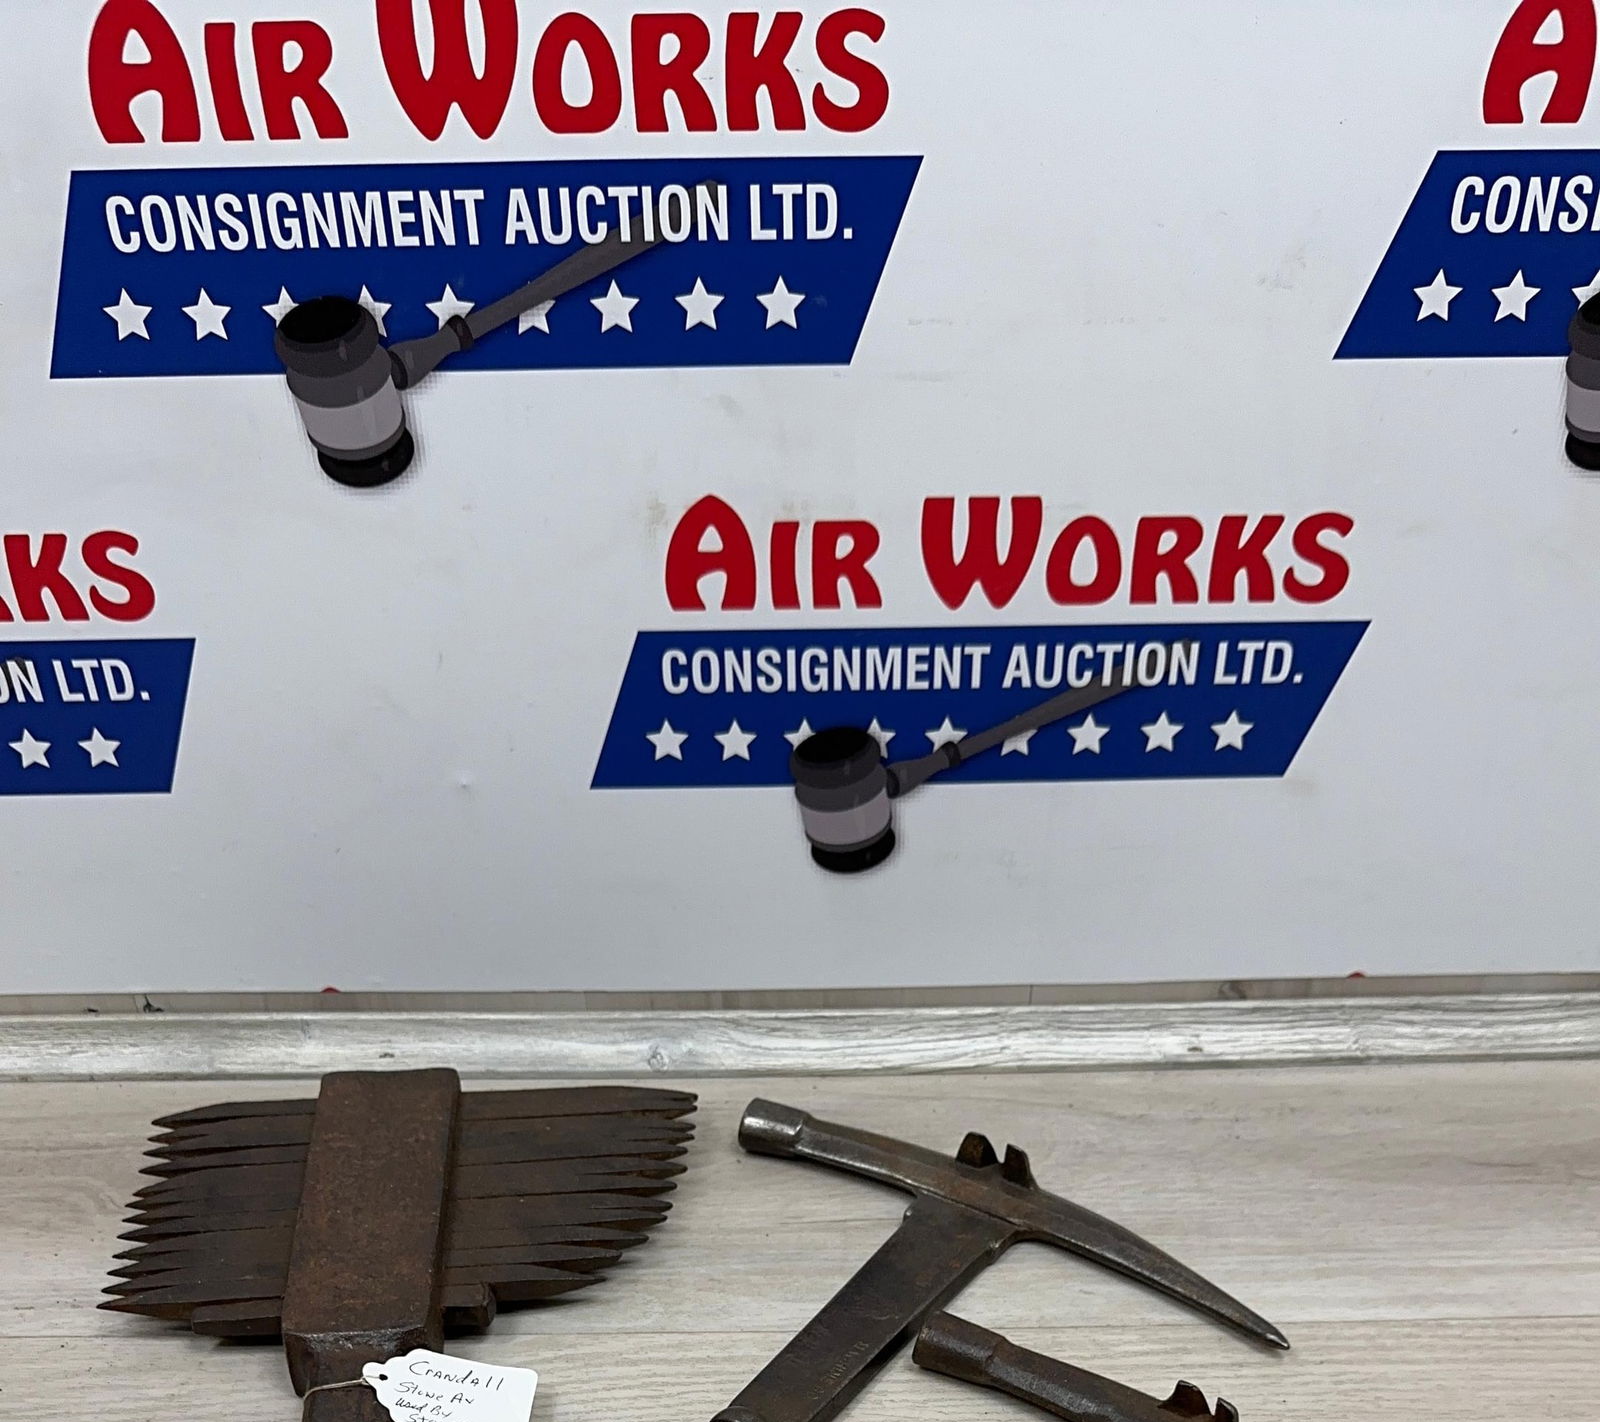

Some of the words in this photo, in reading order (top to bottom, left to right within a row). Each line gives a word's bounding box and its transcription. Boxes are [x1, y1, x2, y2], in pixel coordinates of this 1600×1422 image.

[88, 0, 349, 144] AIR
[375, 0, 889, 142] WORKS
[105, 188, 485, 253] CONSIGNMENT
[505, 184, 729, 245] AUCTION
[749, 183, 853, 241] LTD.
[0, 530, 155, 622] KS
[665, 494, 882, 611] AIR
[921, 496, 1353, 609] WORKS
[52, 658, 150, 702] LTD.
[661, 645, 991, 694] CONSIGNMENT
[1002, 641, 1200, 688] AUCTION
[1214, 641, 1303, 684] LTD.
